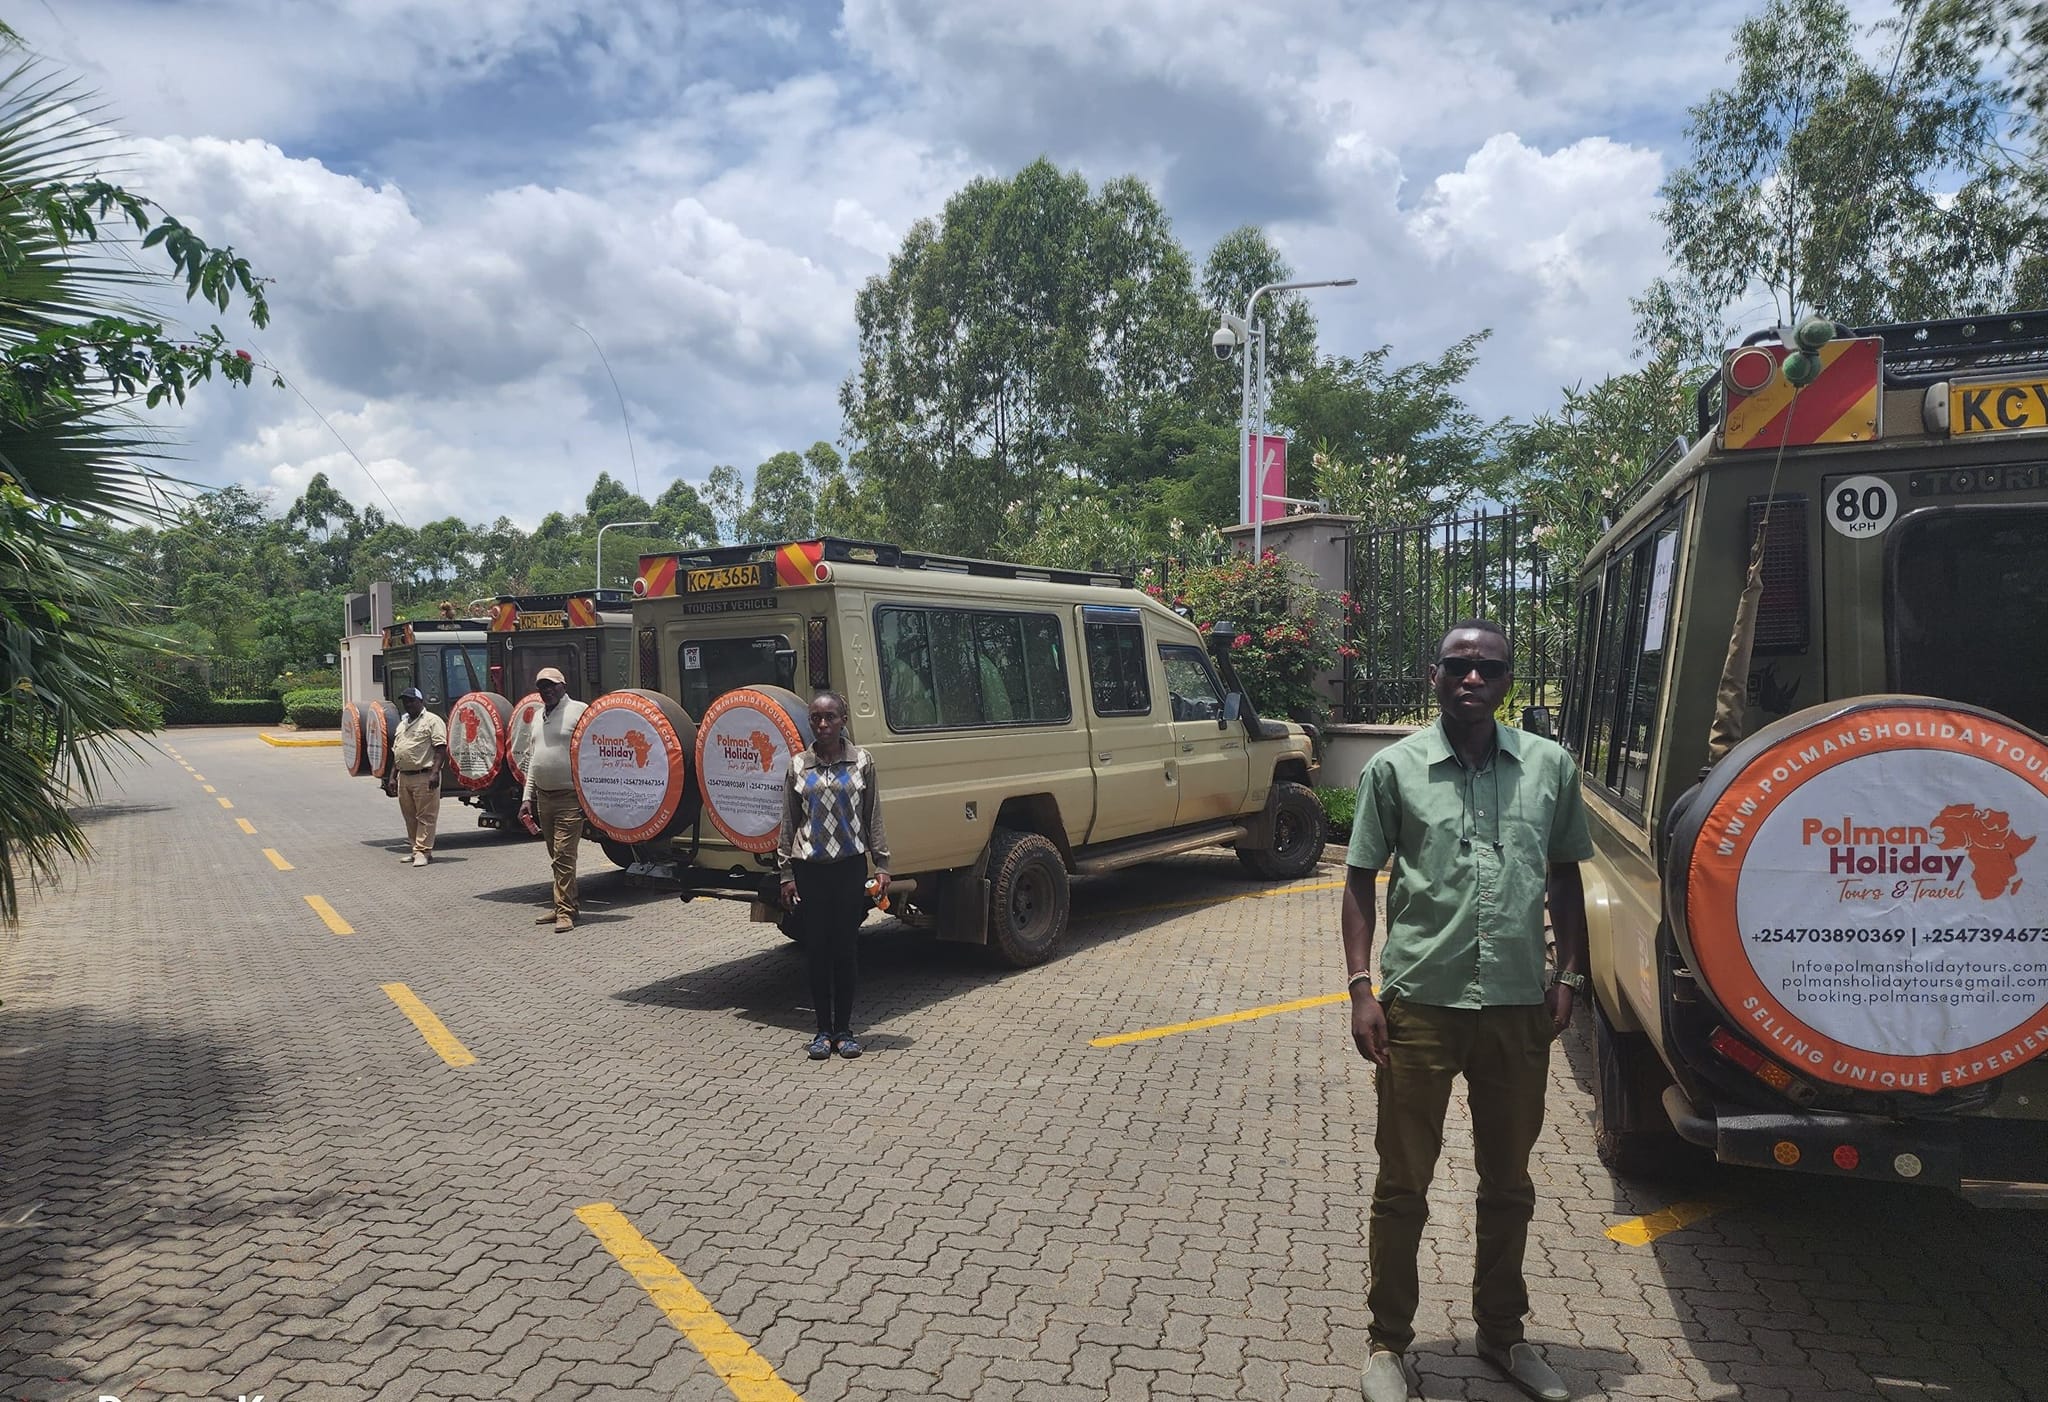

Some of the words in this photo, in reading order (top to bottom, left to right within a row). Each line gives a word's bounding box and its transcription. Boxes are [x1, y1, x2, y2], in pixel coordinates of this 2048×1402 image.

[1836, 487, 1887, 523] 80
[1849, 521, 1877, 532] KPH
[688, 572, 715, 591] KCZ
[721, 566, 760, 586] 365A
[687, 602, 729, 615] TOURIST
[730, 599, 774, 611] VEHICLE
[599, 746, 634, 760] Holiday
[724, 747, 759, 764] Holiday
[1802, 816, 1946, 846] Polmans
[1829, 845, 1965, 881] Holiday
[1837, 878, 1885, 903] Tours
[1891, 880, 1908, 899] &
[1911, 878, 1965, 903] Travel
[1751, 928, 1906, 943] +254703890369
[1797, 989, 2036, 1006] booking.polmans@gmail.com
[1743, 996, 1824, 1064] SELLING
[1832, 1060, 1929, 1087] UNIQUE
